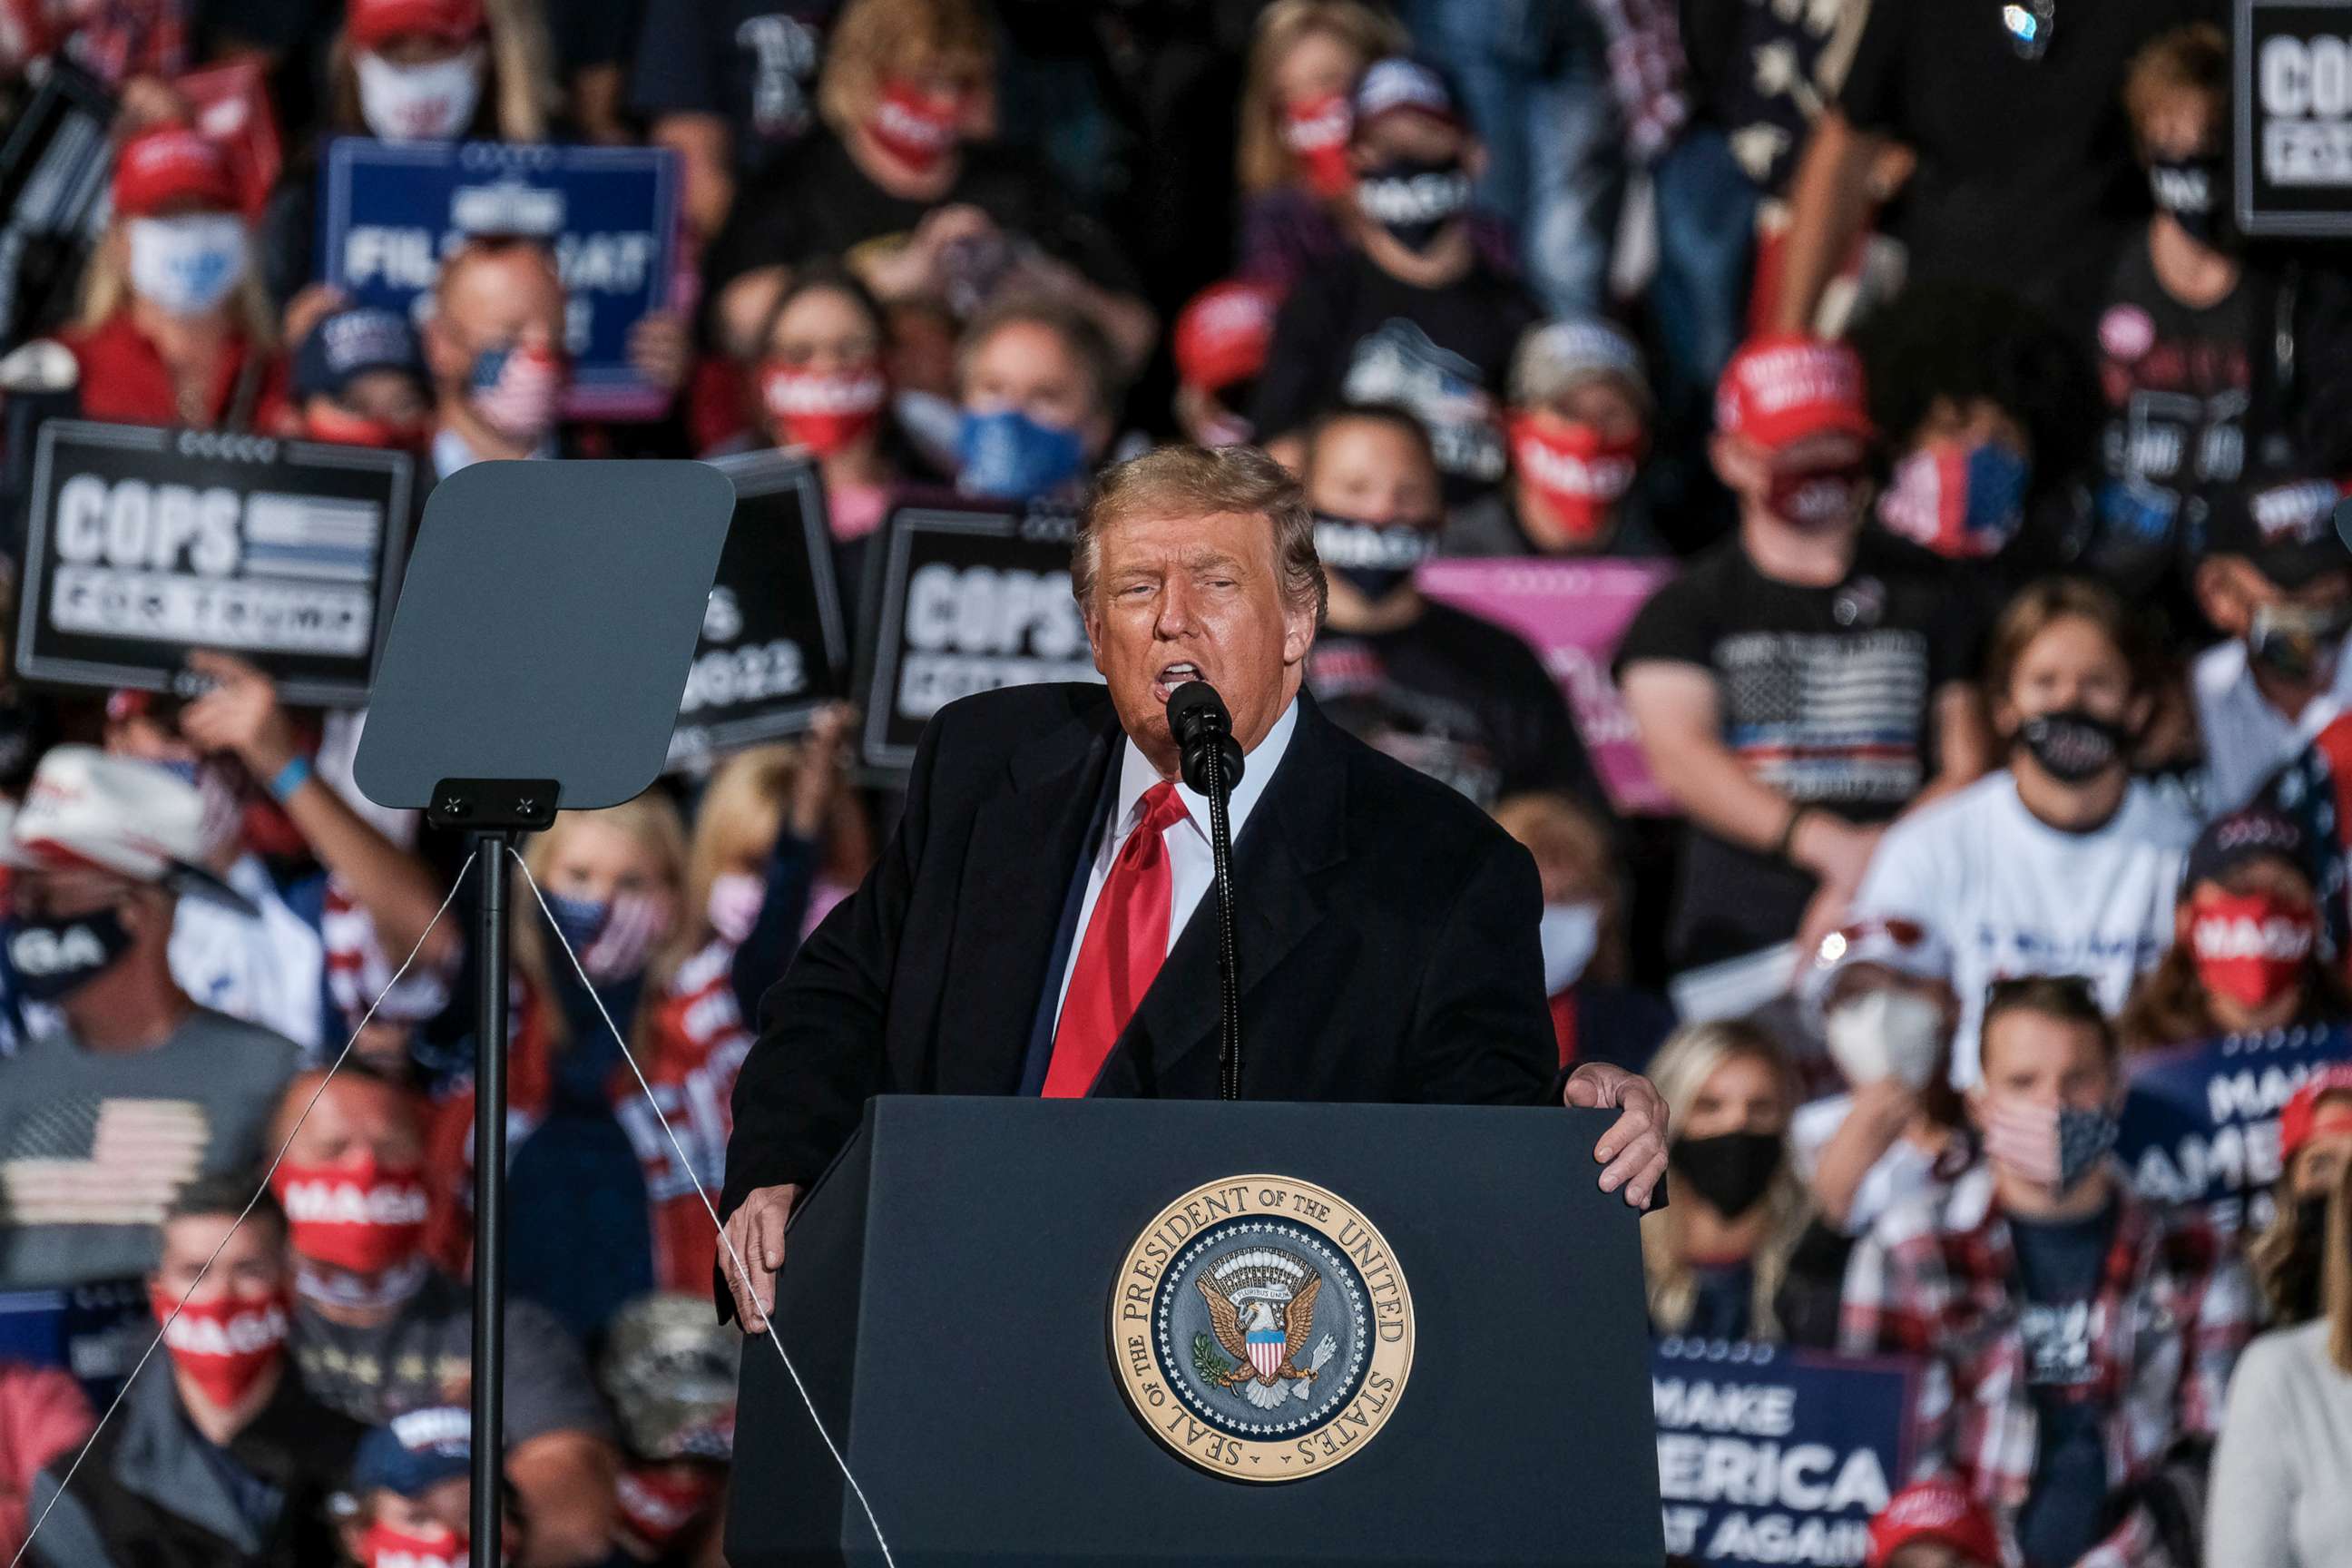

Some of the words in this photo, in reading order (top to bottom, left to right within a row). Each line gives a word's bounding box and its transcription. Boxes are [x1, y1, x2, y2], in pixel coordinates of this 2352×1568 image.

[2259, 34, 2352, 118] CO
[55, 473, 240, 578] COPS
[906, 561, 1085, 661] COPS
[8, 924, 105, 976] GA
[2194, 915, 2311, 962] MAGA
[2133, 1124, 2284, 1201] AME
[285, 1180, 427, 1223] MAGA
[1259, 1190, 1287, 1208] OF
[1293, 1194, 1330, 1223] THE
[1123, 1186, 1249, 1322] PRESIDENT
[1338, 1219, 1404, 1343] UNITED
[1237, 1289, 1269, 1298] PLURIBUS
[1128, 1335, 1152, 1377] THE
[1142, 1381, 1166, 1407] OF
[1298, 1371, 1395, 1465] STATES
[1653, 1377, 1797, 1436] MAKE
[1167, 1405, 1243, 1465] SEAL
[1656, 1433, 1889, 1515] ERICA
